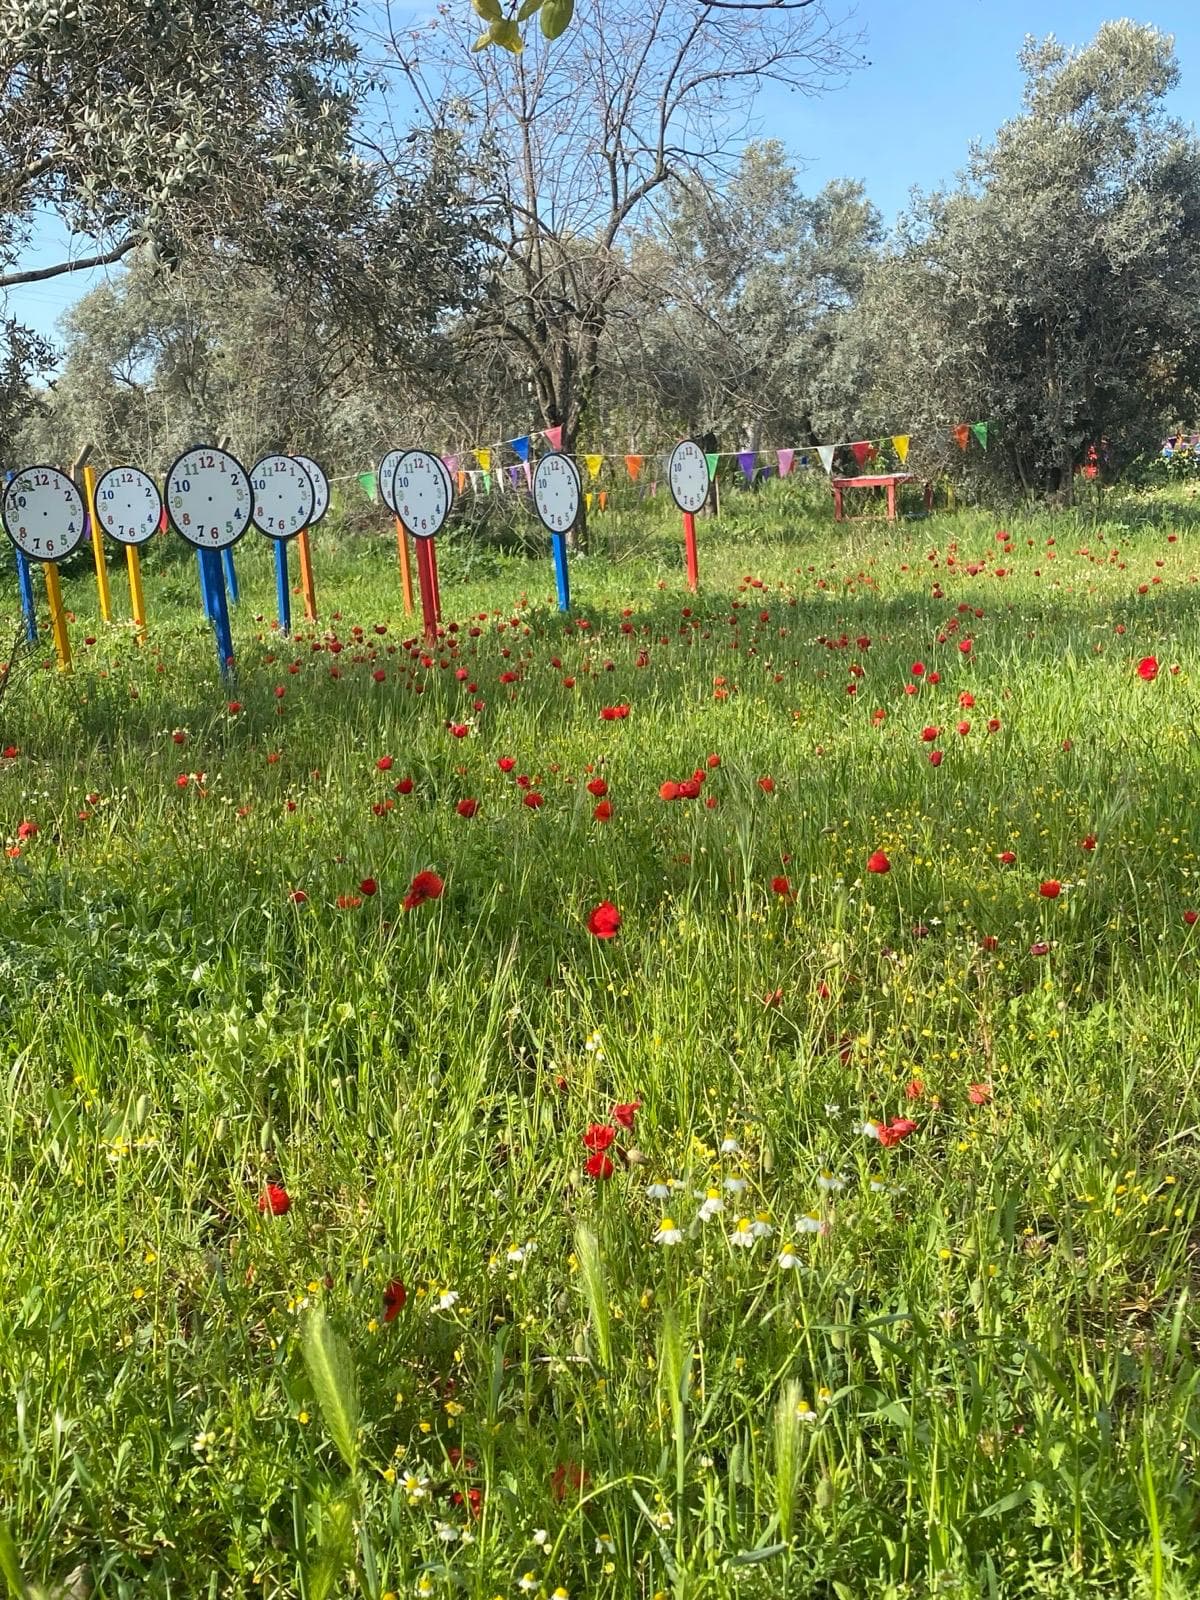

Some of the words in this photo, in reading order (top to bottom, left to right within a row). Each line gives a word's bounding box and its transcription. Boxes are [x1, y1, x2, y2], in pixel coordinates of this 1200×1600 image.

[199, 456, 215, 468] 12
[219, 461, 226, 472] 1
[274, 462, 286, 472] 12
[414, 458, 423, 468] 12
[551, 461, 559, 470] 12
[184, 463, 199, 475] 11
[262, 467, 274, 476] 11
[290, 467, 295, 476] 1
[404, 464, 413, 473] 11
[426, 464, 430, 473] 1
[544, 466, 551, 475] 11
[561, 466, 565, 474] 1
[34, 474, 49, 486] 12
[110, 479, 121, 487] 11
[121, 474, 133, 482] 12
[137, 478, 142, 486] 1
[231, 474, 239, 485] 2
[298, 478, 304, 488] 2
[399, 477, 409, 487] 10
[433, 475, 438, 485] 2
[567, 476, 571, 484] 2
[53, 479, 60, 490] 1
[175, 480, 190, 492] 10
[253, 480, 265, 490] 10
[539, 479, 547, 488] 10
[65, 490, 72, 502] 2
[102, 490, 114, 499] 10
[145, 488, 152, 497] 2
[236, 489, 244, 501] 3
[301, 491, 307, 500] 3
[174, 496, 182, 508] 9
[569, 502, 573, 511] 4
[70, 505, 77, 516] 3
[234, 508, 242, 520] 4
[257, 507, 263, 516] 8
[298, 505, 304, 515] 4
[404, 505, 409, 516] 8
[436, 504, 440, 514] 4
[543, 505, 547, 514] 8
[11, 511, 19, 522] 9
[108, 516, 113, 524] 8
[147, 514, 153, 523] 4
[183, 513, 191, 525] 8
[290, 516, 296, 526] 5
[431, 515, 435, 525] 5
[550, 514, 554, 524] 7
[558, 516, 562, 526] 6
[565, 512, 569, 521] 5
[226, 521, 233, 533] 5
[268, 518, 274, 527] 7
[279, 520, 285, 530] 6
[413, 517, 418, 527] 7
[422, 519, 426, 529] 6
[20, 527, 27, 538] 8
[68, 522, 75, 533] 4
[119, 525, 124, 534] 7
[129, 528, 135, 536] 6
[141, 524, 146, 533] 5
[197, 525, 204, 537] 7
[211, 527, 218, 539] 6
[33, 538, 40, 549] 7
[60, 534, 67, 545] 5
[46, 540, 54, 551] 6
